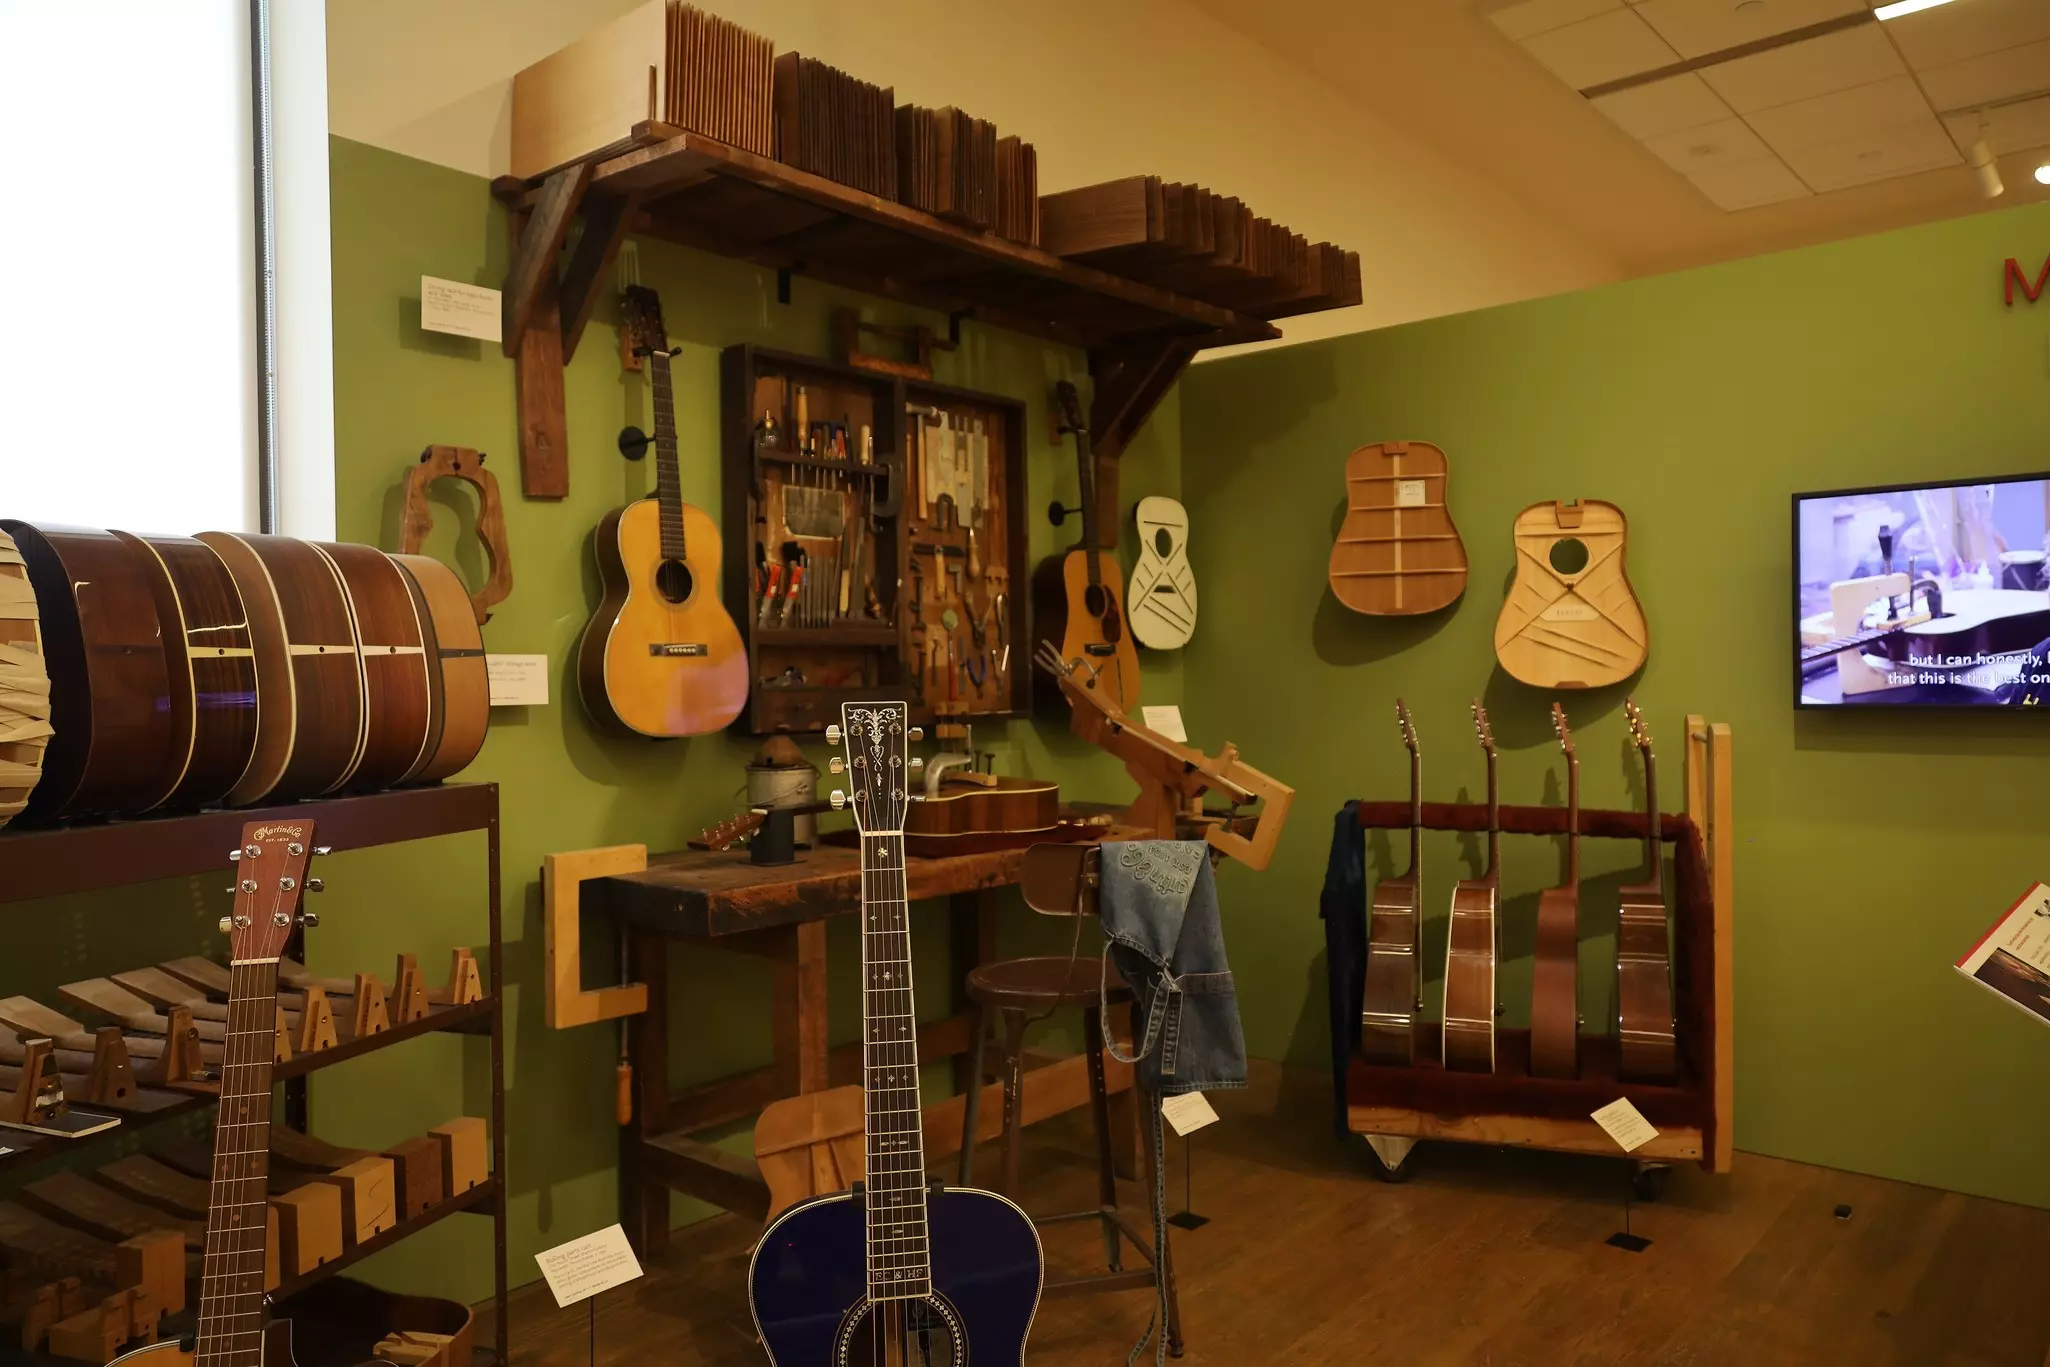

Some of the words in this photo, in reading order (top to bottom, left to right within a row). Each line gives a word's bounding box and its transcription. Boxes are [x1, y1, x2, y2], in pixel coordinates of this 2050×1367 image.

[1910, 653, 1933, 666] but
[1937, 653, 1942, 665] I
[1946, 655, 1972, 665] can
[1976, 651, 2043, 667] honestly,
[1888, 671, 1916, 684] that
[1918, 671, 1946, 684] this
[1950, 672, 1962, 684] is
[1967, 671, 1991, 684] the
[1994, 671, 2027, 684] best
